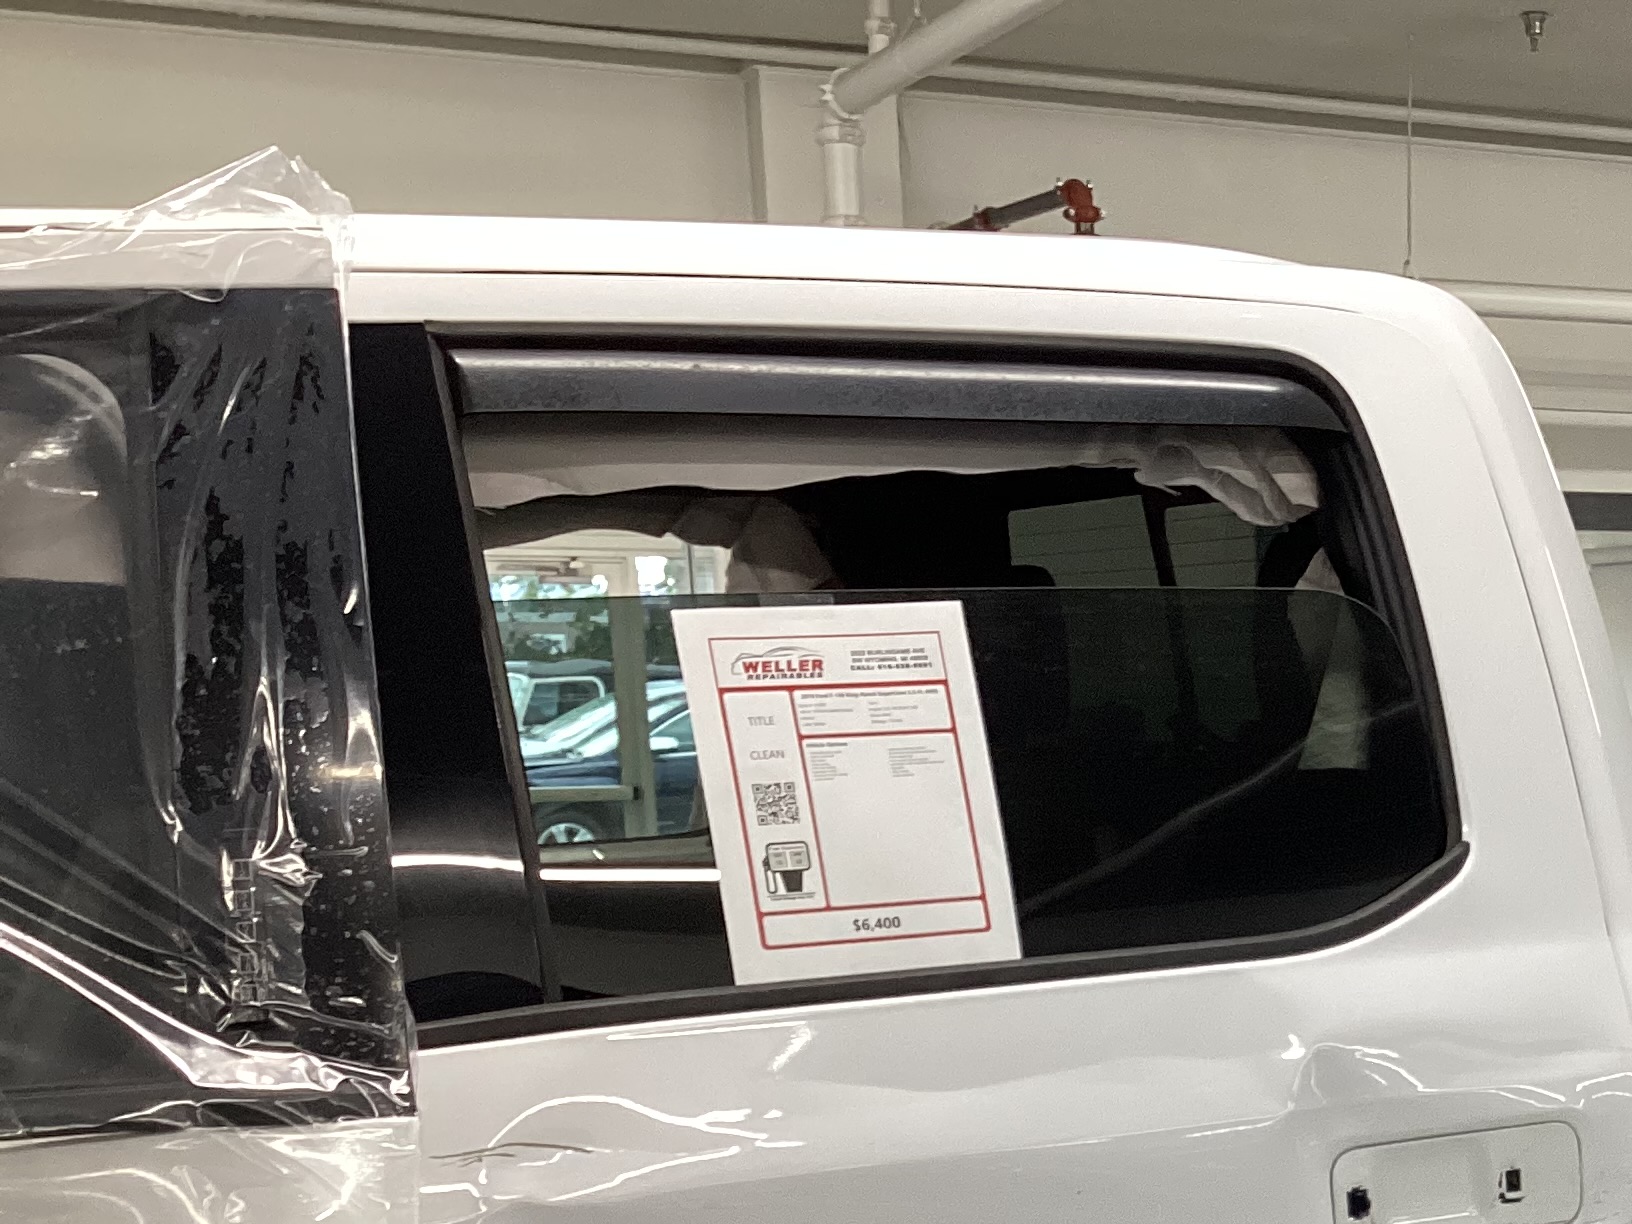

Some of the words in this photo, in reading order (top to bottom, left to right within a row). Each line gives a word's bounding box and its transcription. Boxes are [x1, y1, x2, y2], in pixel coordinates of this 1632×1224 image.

[742, 659, 824, 674] WELLER
[747, 671, 823, 680] REPAIRABLES
[747, 716, 775, 726] TITLE
[750, 749, 785, 760] CLEAN
[852, 916, 901, 932] $6,400
